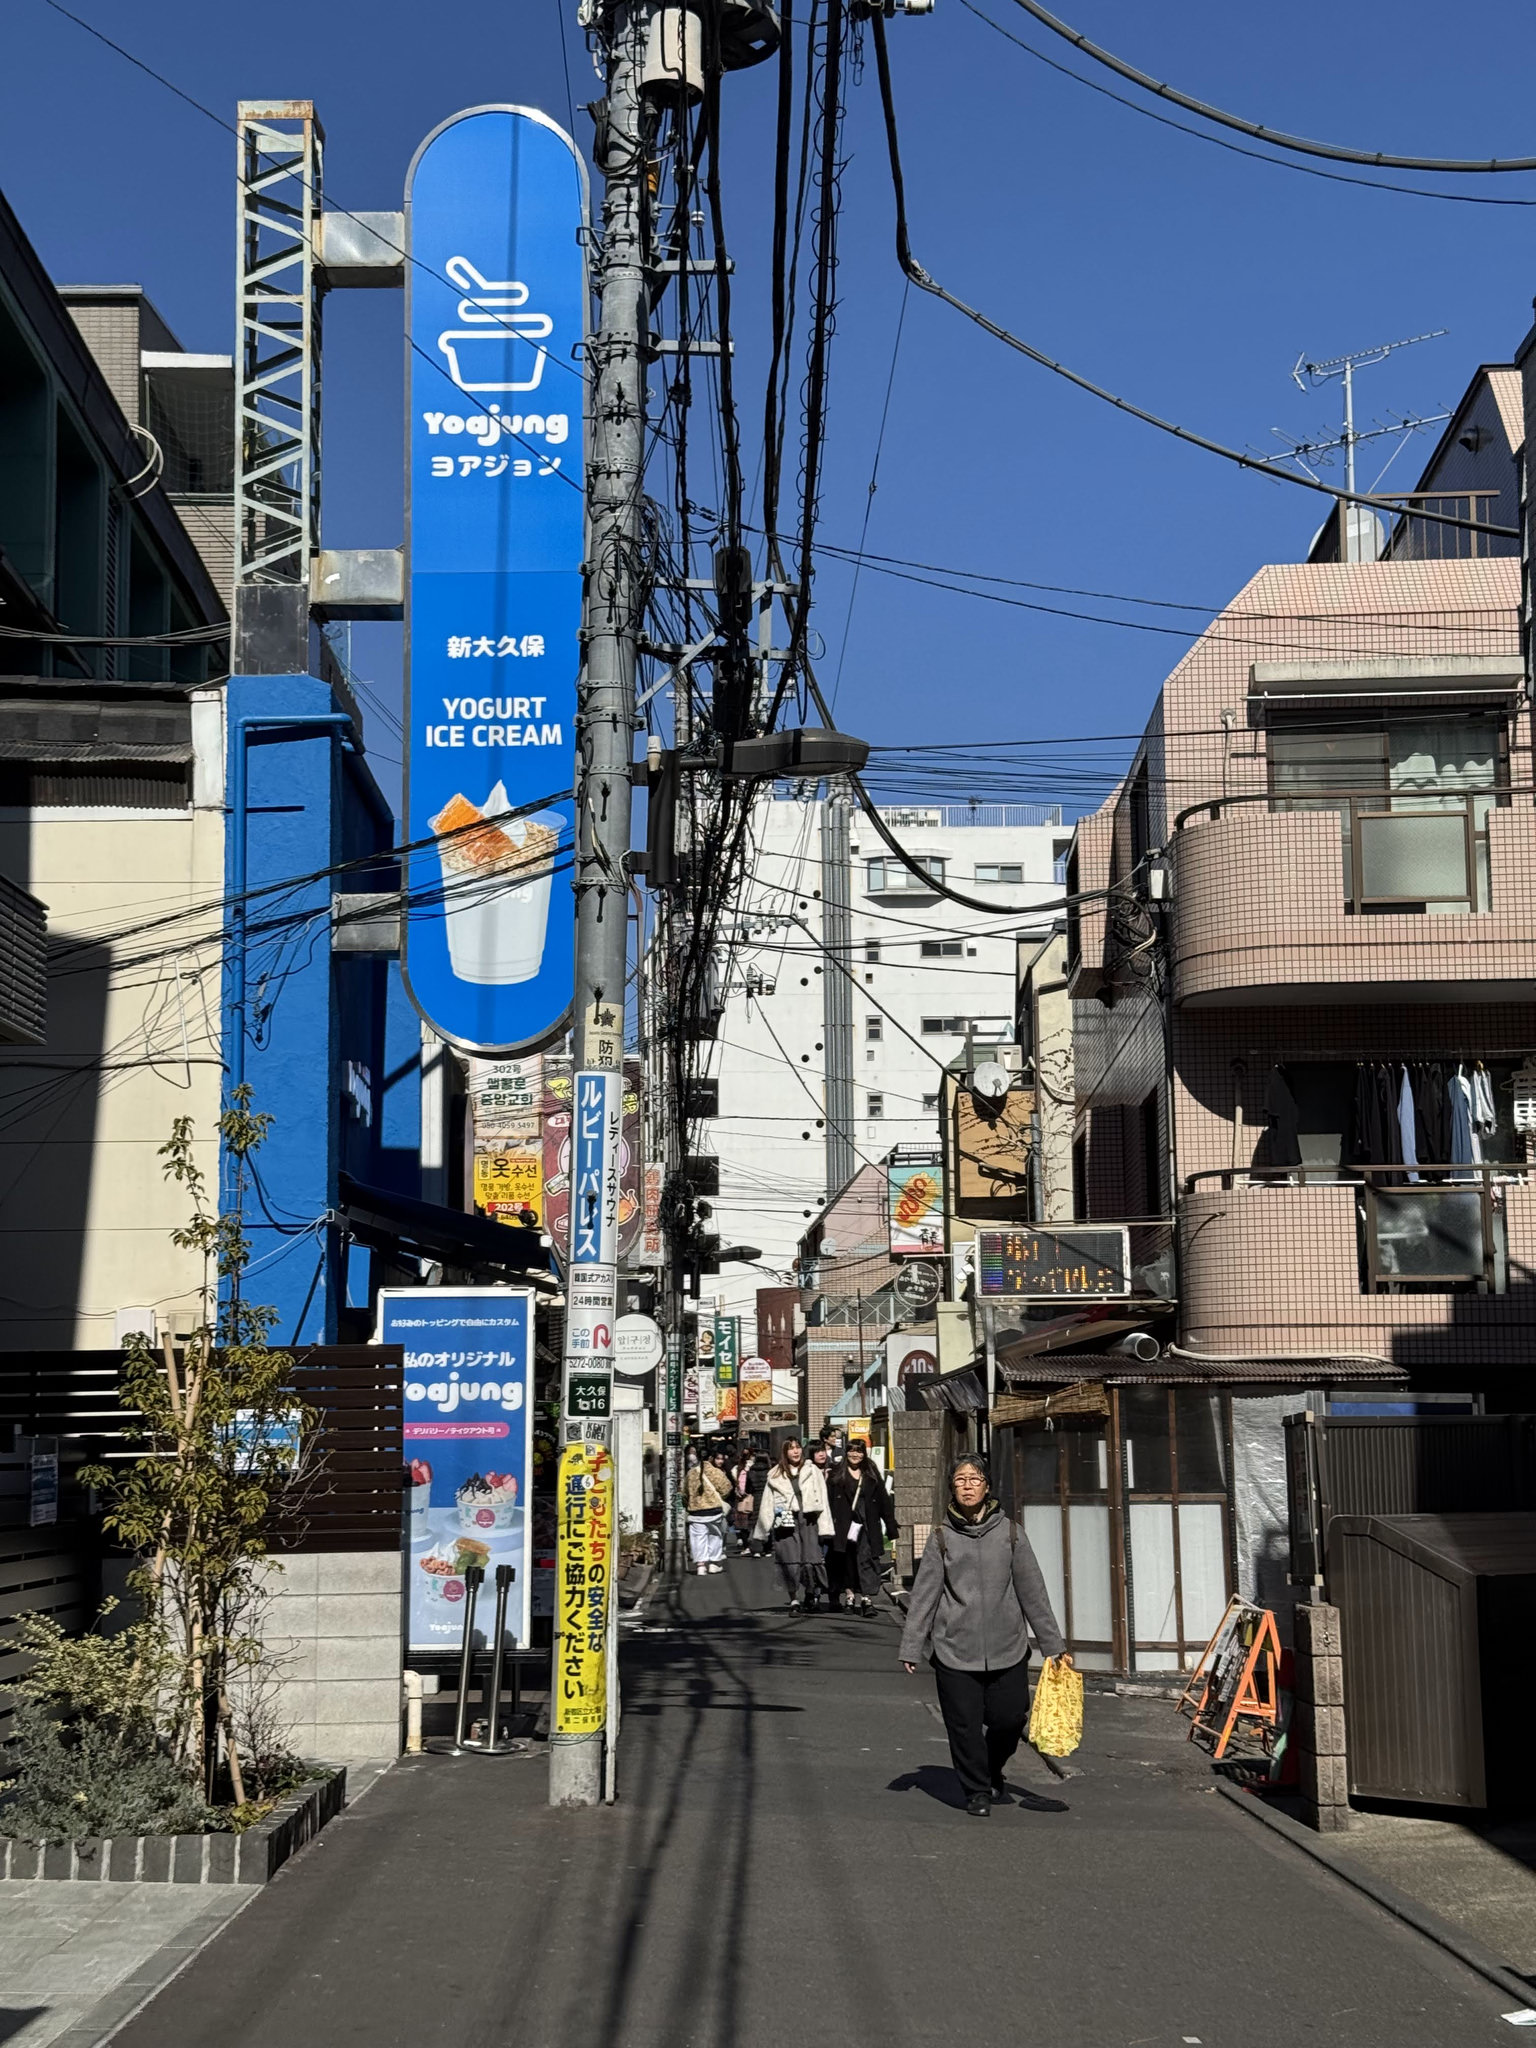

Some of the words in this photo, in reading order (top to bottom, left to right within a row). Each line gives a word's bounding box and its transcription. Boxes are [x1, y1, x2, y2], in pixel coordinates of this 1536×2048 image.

[423, 404, 568, 446] Yoajung
[431, 455, 562, 477] ヨアジョン
[447, 635, 545, 659] 新大久保
[442, 697, 546, 720] YOGURT
[426, 725, 465, 747] ICE
[472, 724, 562, 747] CREAM
[492, 1158, 537, 1179] 옷수선
[577, 1080, 603, 1258] ルビーパレス
[605, 1111, 620, 1228] レディースサウナ
[573, 1296, 613, 1307] 24時間営業
[391, 1318, 520, 1328] お好みのトッピングで自由にカスタム
[572, 1328, 590, 1338] この
[572, 1338, 590, 1349] 手前
[718, 1321, 732, 1365] モイセ
[403, 1351, 516, 1368] 私のオリジナル
[403, 1371, 523, 1413] oajung
[575, 1385, 606, 1396] 大久保
[576, 1399, 606, 1410] 116
[587, 1451, 608, 1653] 子どもたちの安全な
[564, 1474, 587, 1700] 通行にご協力ください
[429, 1621, 464, 1634] Yoajun
